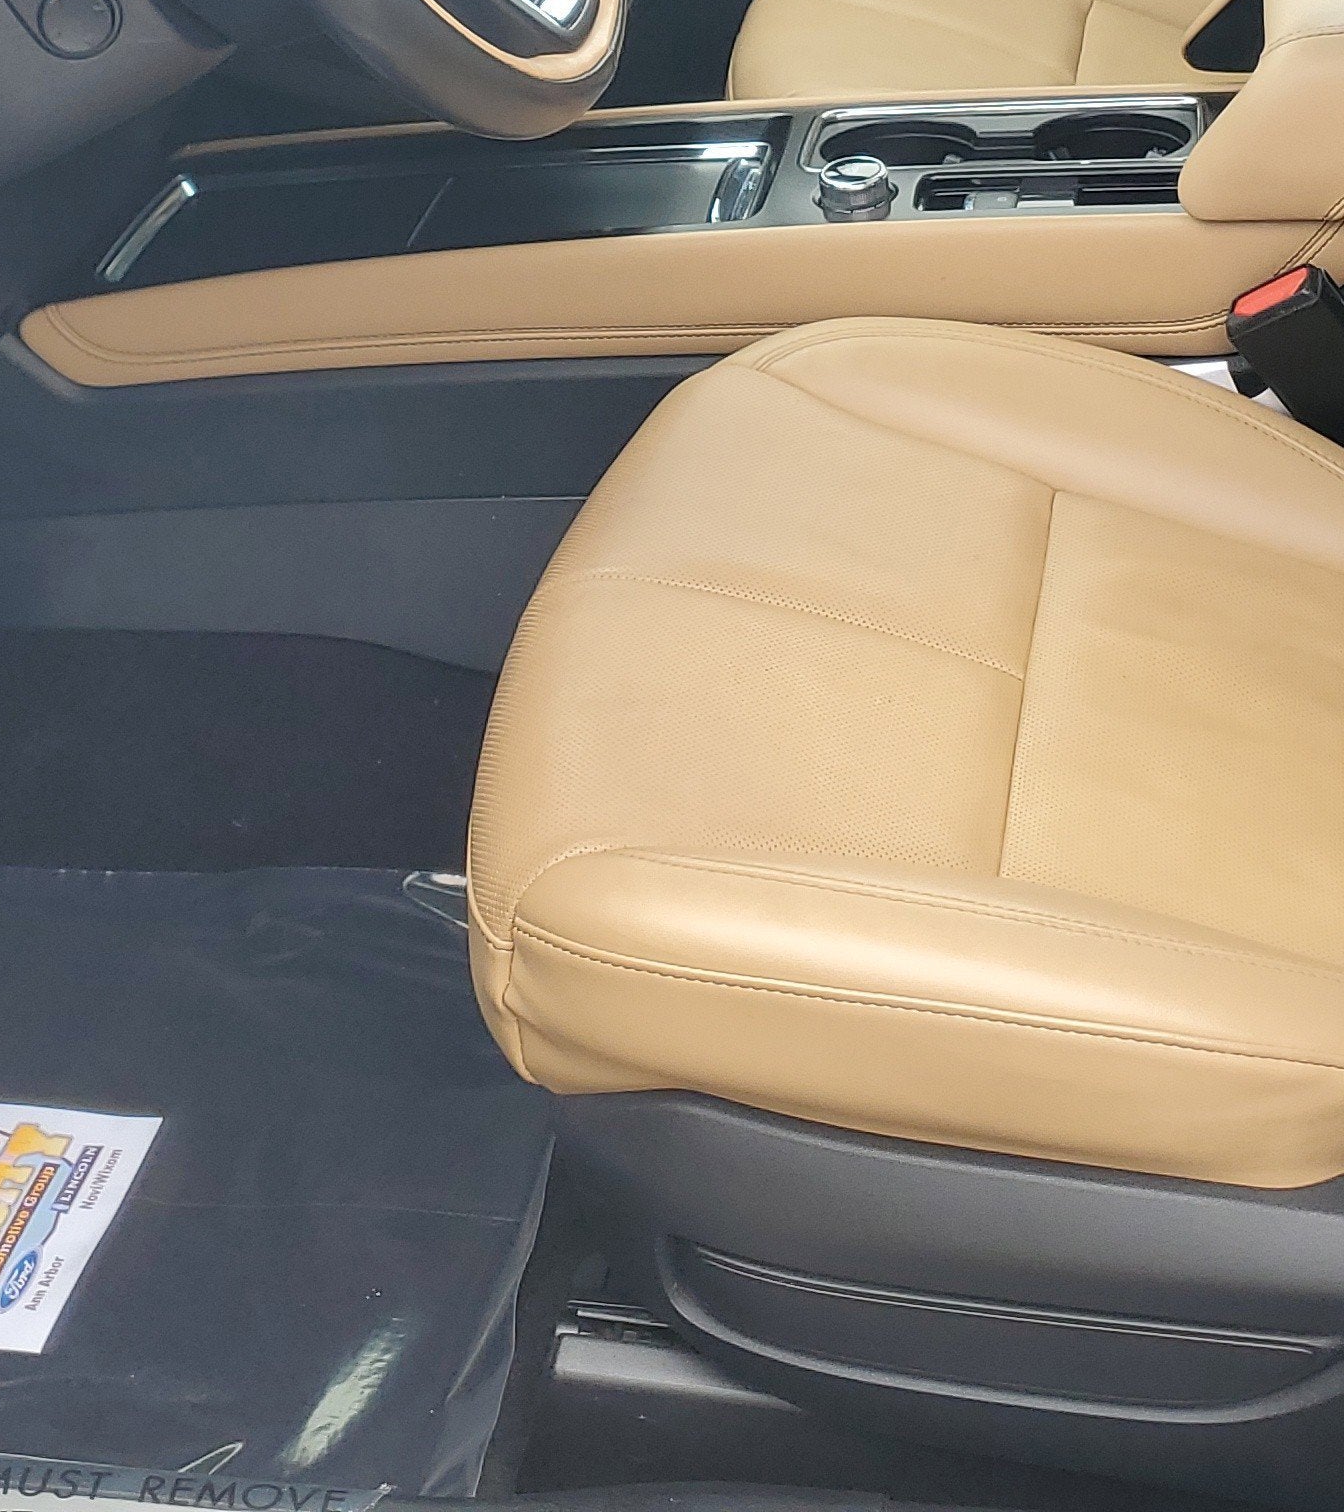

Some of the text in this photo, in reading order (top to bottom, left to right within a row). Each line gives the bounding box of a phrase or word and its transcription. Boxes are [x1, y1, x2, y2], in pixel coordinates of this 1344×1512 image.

[24, 1165, 57, 1208] Group
[60, 1145, 99, 1202] LINCOLN
[4, 1259, 36, 1300] Ford
[25, 1255, 65, 1312] Ann Arbor
[137, 1474, 348, 1512] REMOVE
